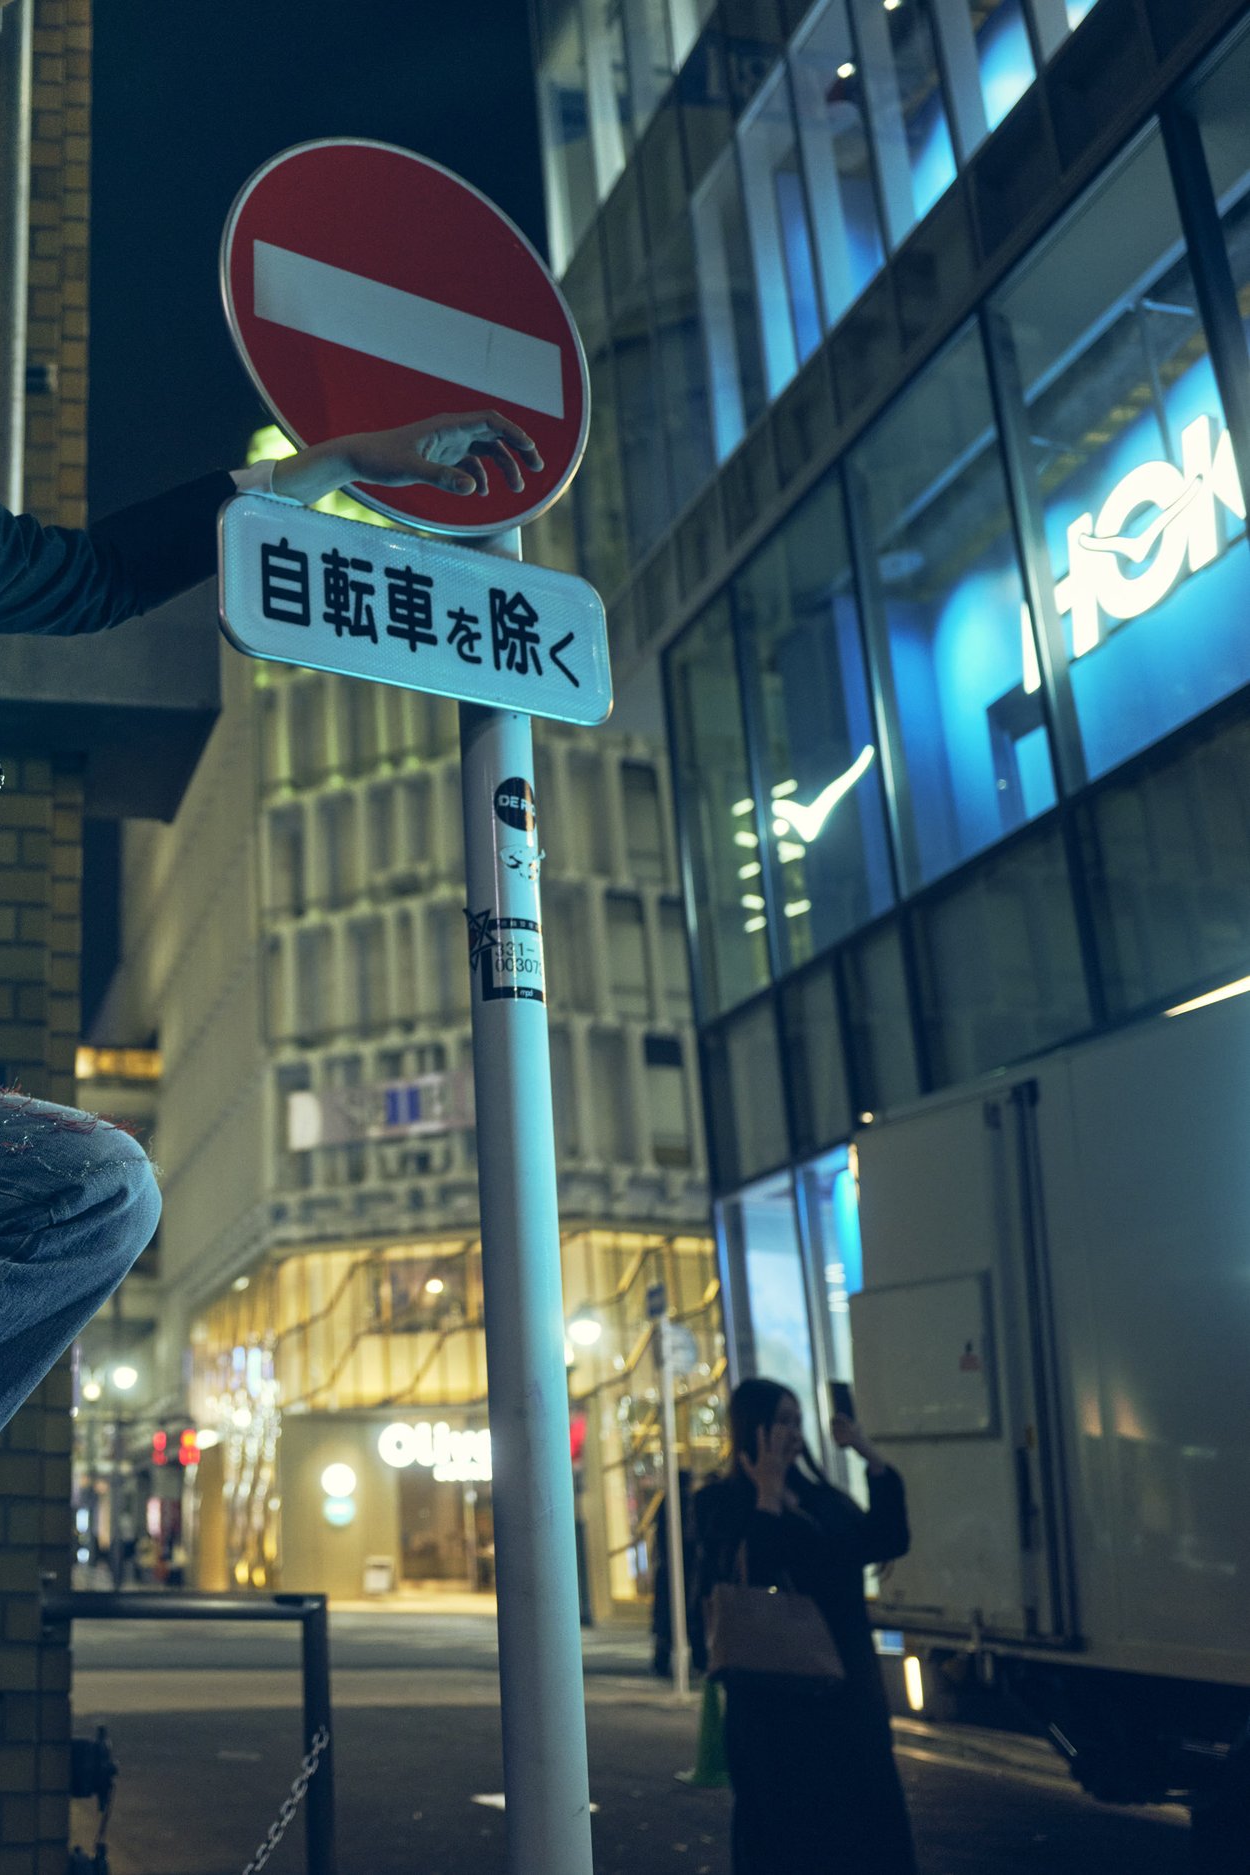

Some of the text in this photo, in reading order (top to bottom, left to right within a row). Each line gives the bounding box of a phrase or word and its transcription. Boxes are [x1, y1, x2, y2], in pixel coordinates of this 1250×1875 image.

[260, 536, 580, 689] 自転車を除く
